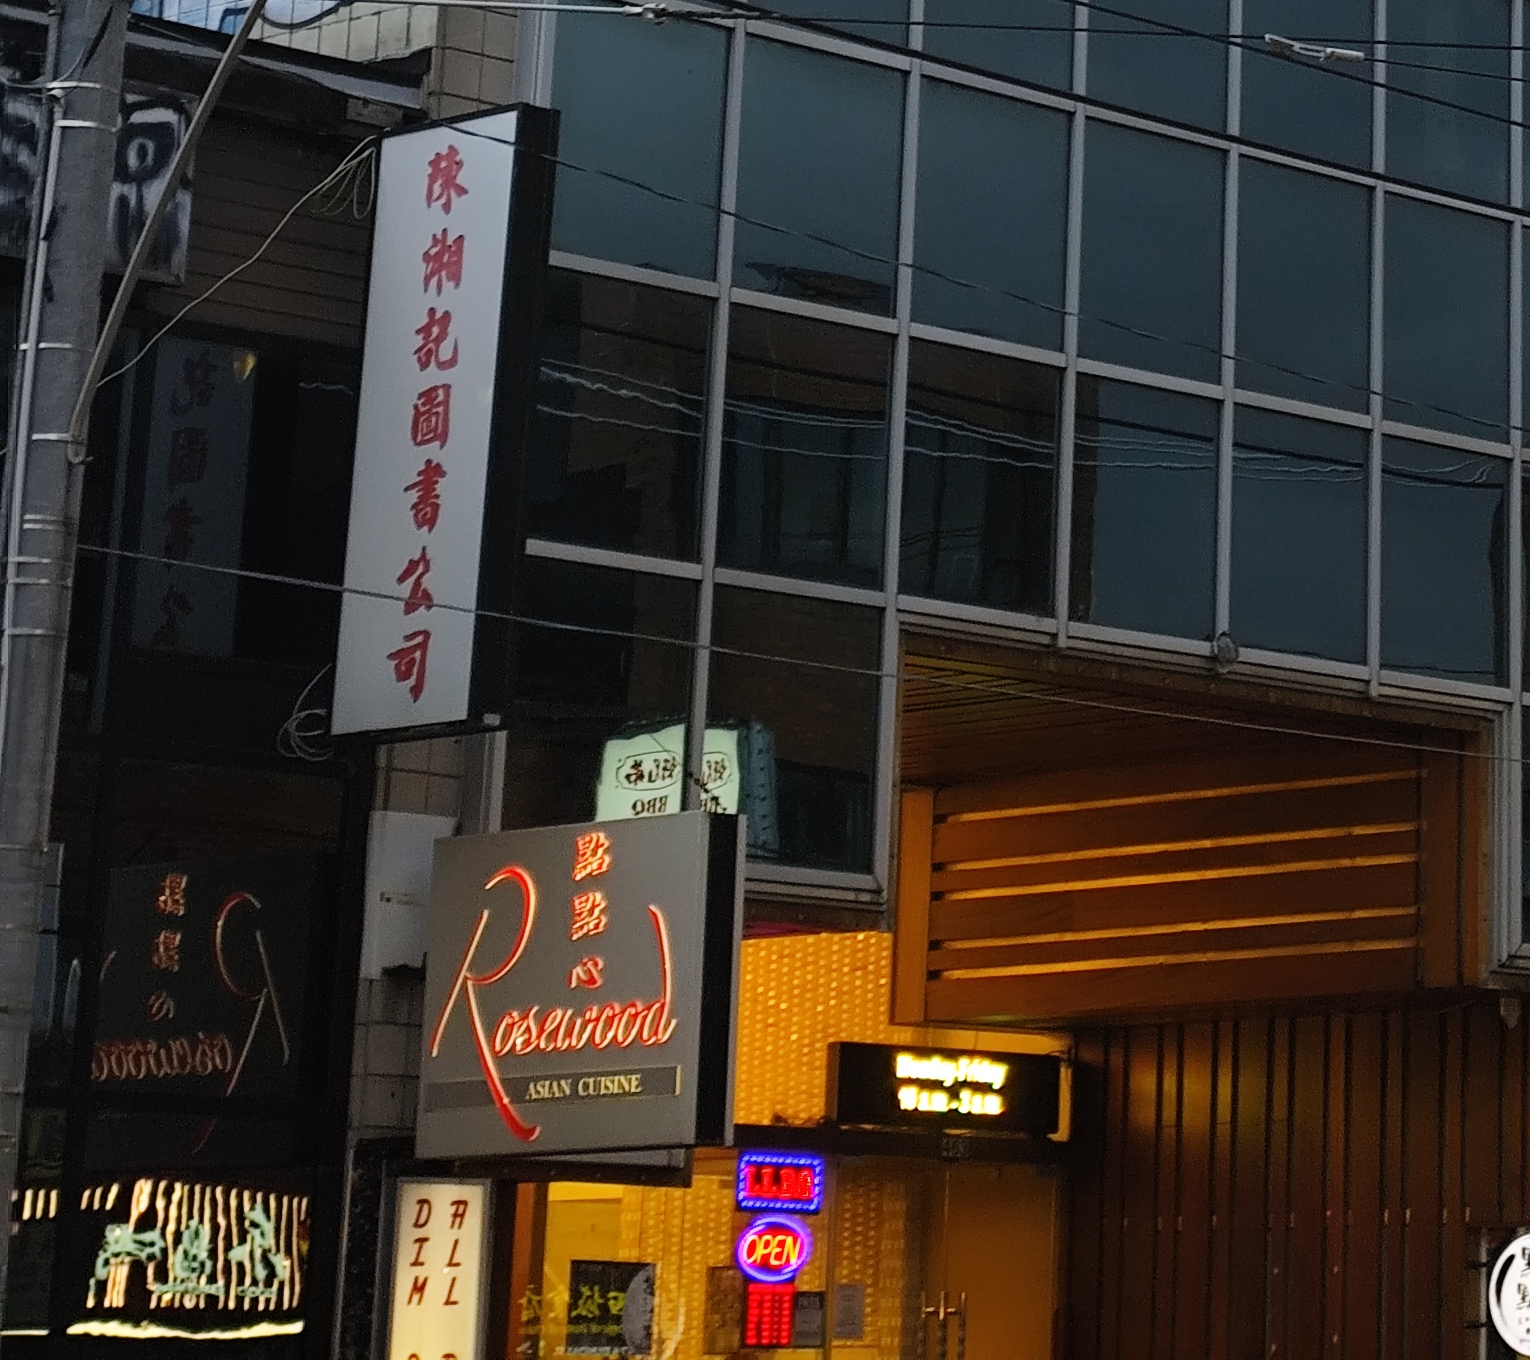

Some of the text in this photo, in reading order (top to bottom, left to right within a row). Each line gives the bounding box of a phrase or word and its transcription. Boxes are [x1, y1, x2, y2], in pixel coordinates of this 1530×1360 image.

[430, 862, 677, 1142] Rosewood
[525, 1074, 643, 1100] ASIAN CUISINE
[743, 1233, 802, 1266] OPEN
